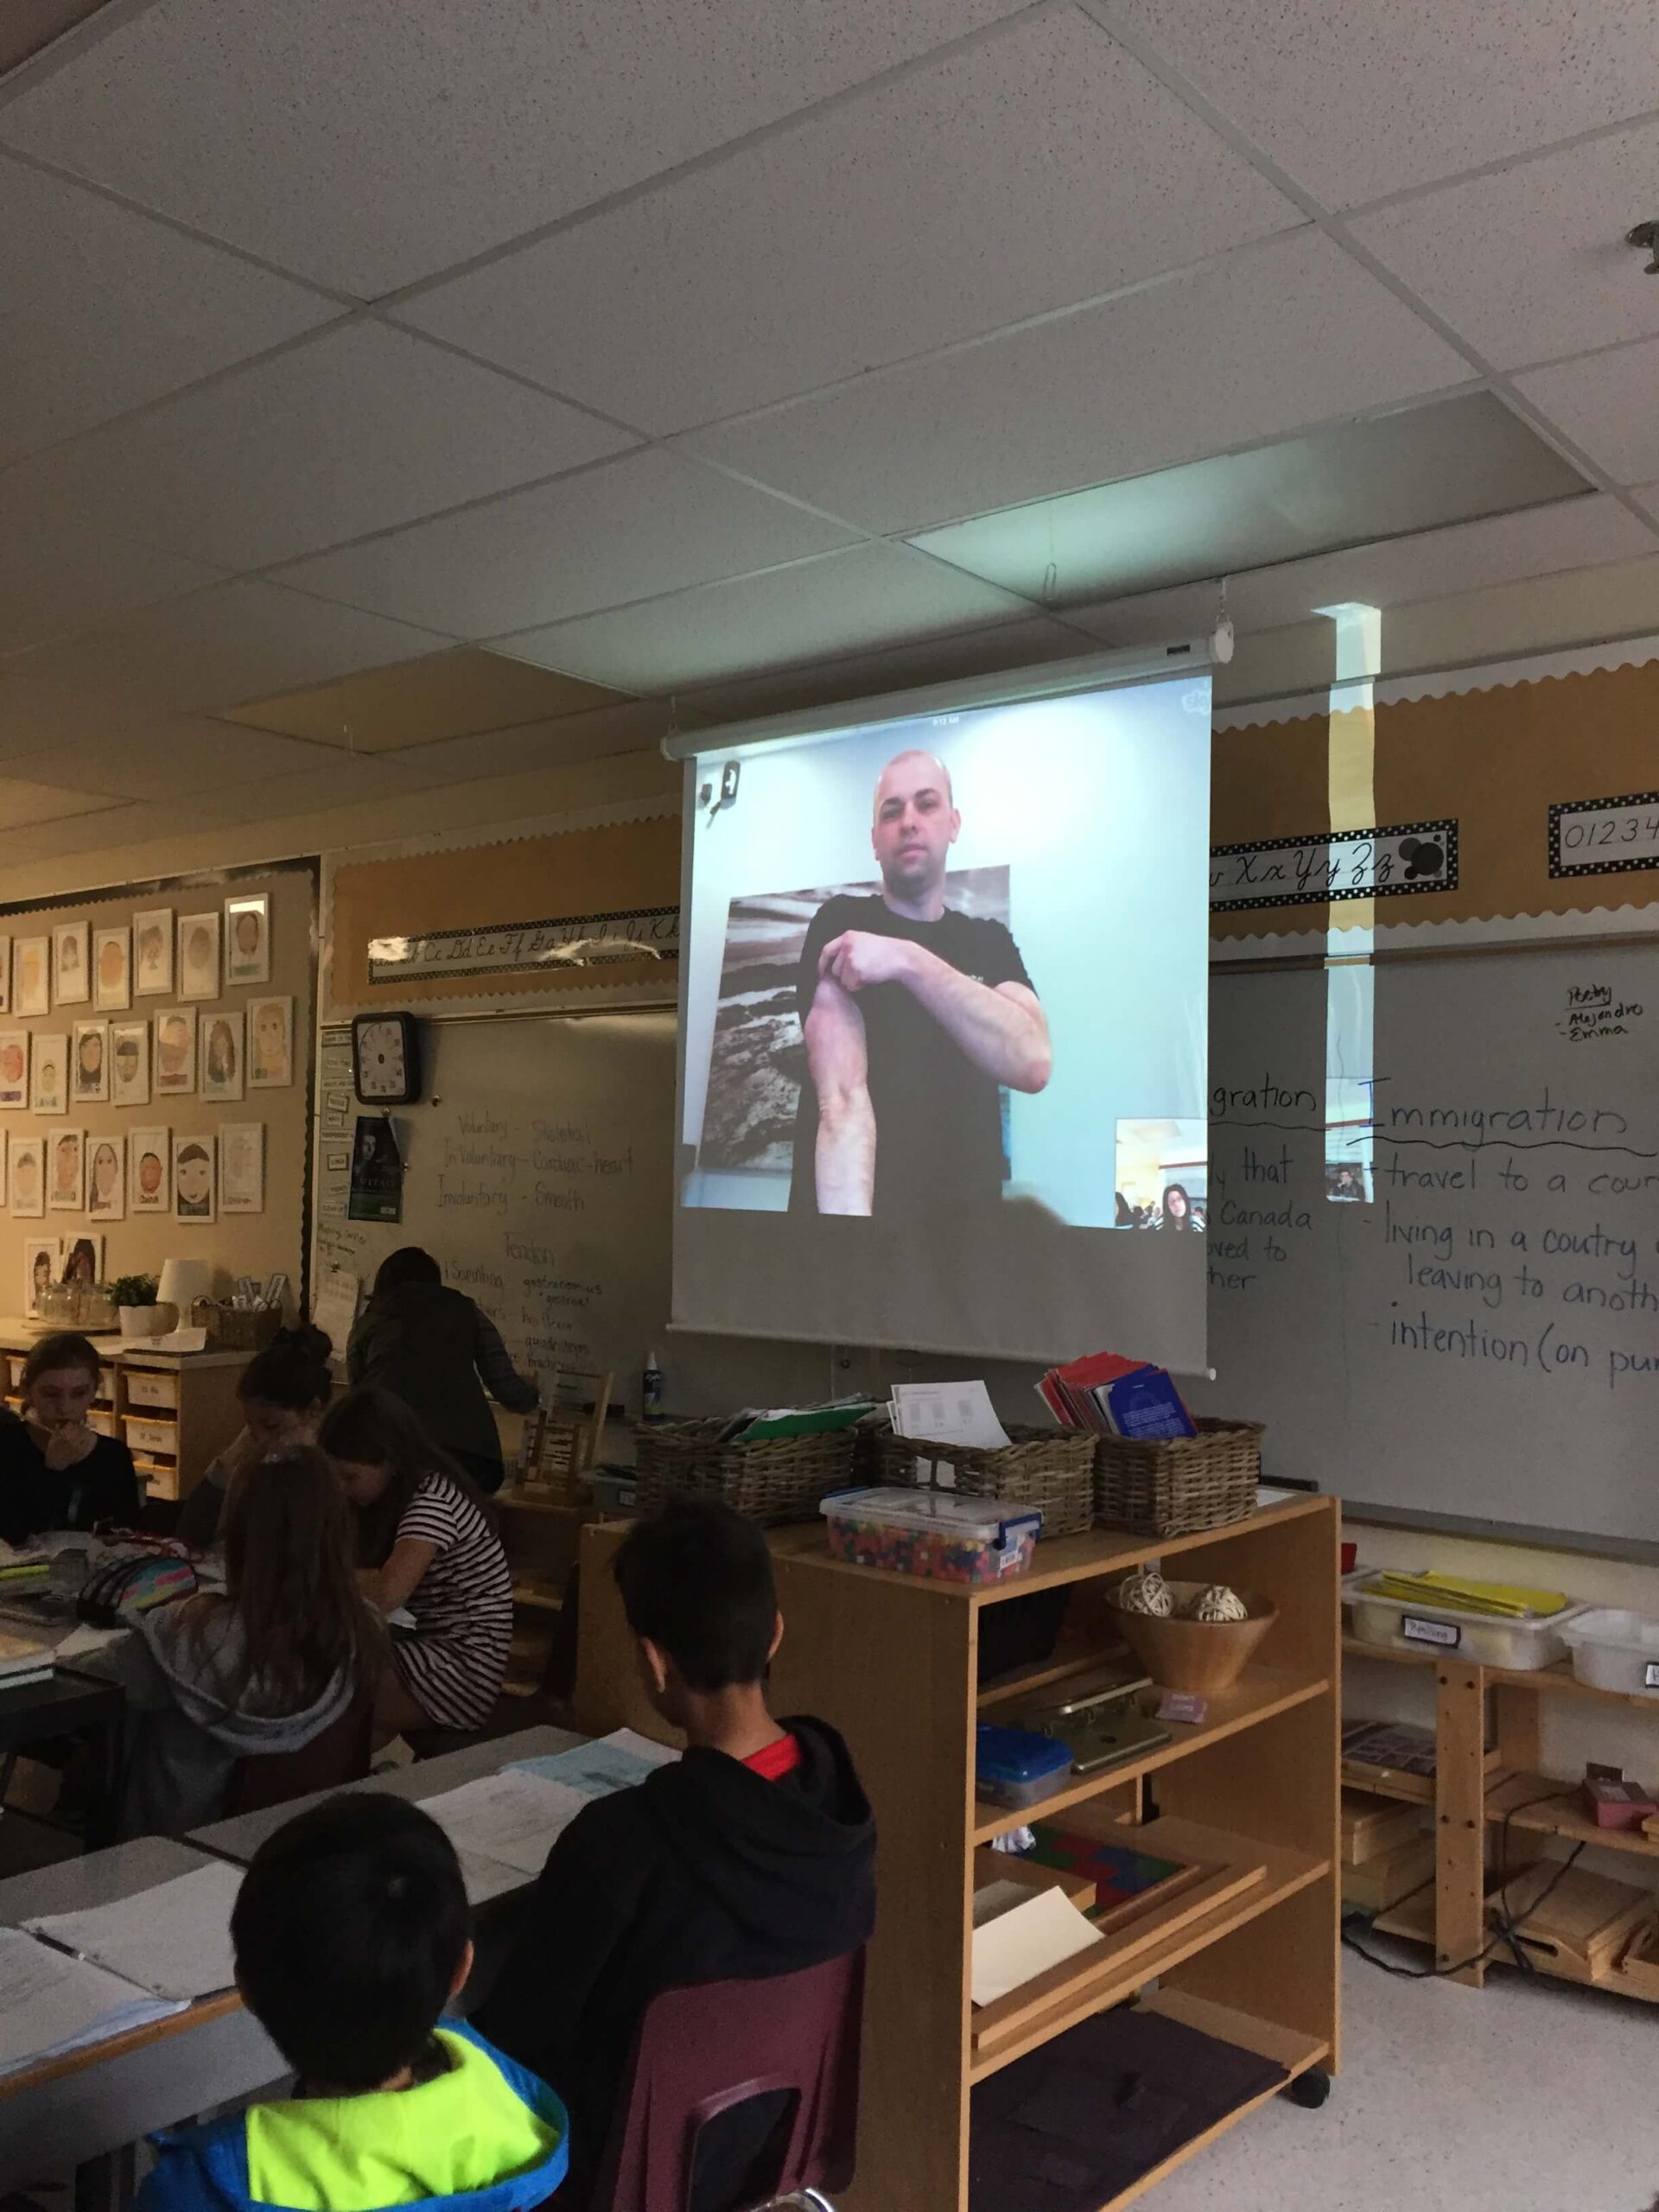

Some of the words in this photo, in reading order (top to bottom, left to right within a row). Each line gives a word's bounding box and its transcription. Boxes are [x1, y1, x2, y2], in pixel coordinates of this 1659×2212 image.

[1569, 1002, 1643, 1027] Alejandro
[1569, 1025, 1629, 1042] Emma
[1244, 1144, 1294, 1184] that
[1384, 1152, 1476, 1189] travel
[1498, 1157, 1529, 1192] to
[1547, 1174, 1567, 1193] a
[1220, 1200, 1313, 1230] Canada
[1385, 1199, 1453, 1262] living
[1469, 1228, 1495, 1249] in
[1511, 1230, 1528, 1251] a
[1263, 1235, 1287, 1262] to
[1408, 1253, 1503, 1309] leaving
[1514, 1264, 1544, 1298] to
[1390, 1300, 1529, 1367] intention
